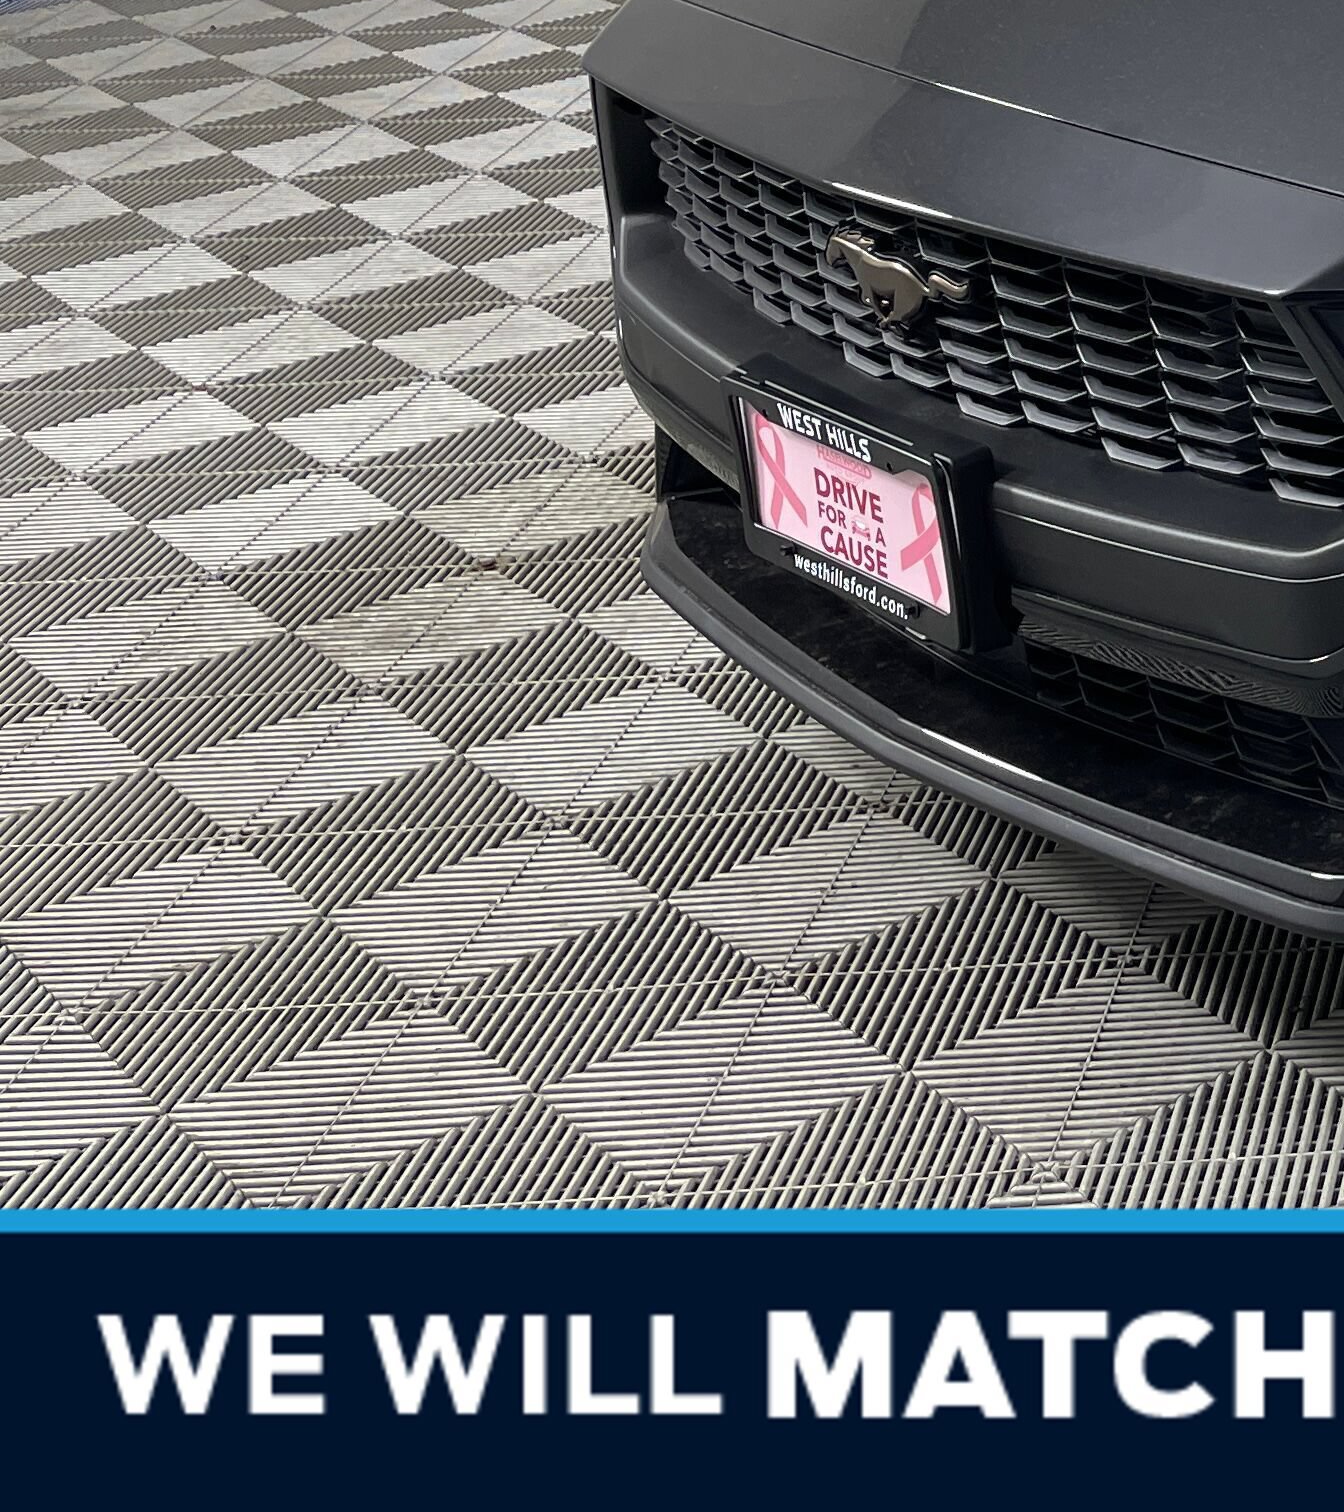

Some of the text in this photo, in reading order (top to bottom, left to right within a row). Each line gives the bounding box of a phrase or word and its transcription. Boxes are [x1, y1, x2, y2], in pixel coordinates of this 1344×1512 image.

[777, 402, 872, 463] WEST HILLS
[813, 467, 884, 525] DRIVE
[818, 501, 887, 548] FOR A
[820, 525, 889, 580] CAUSE
